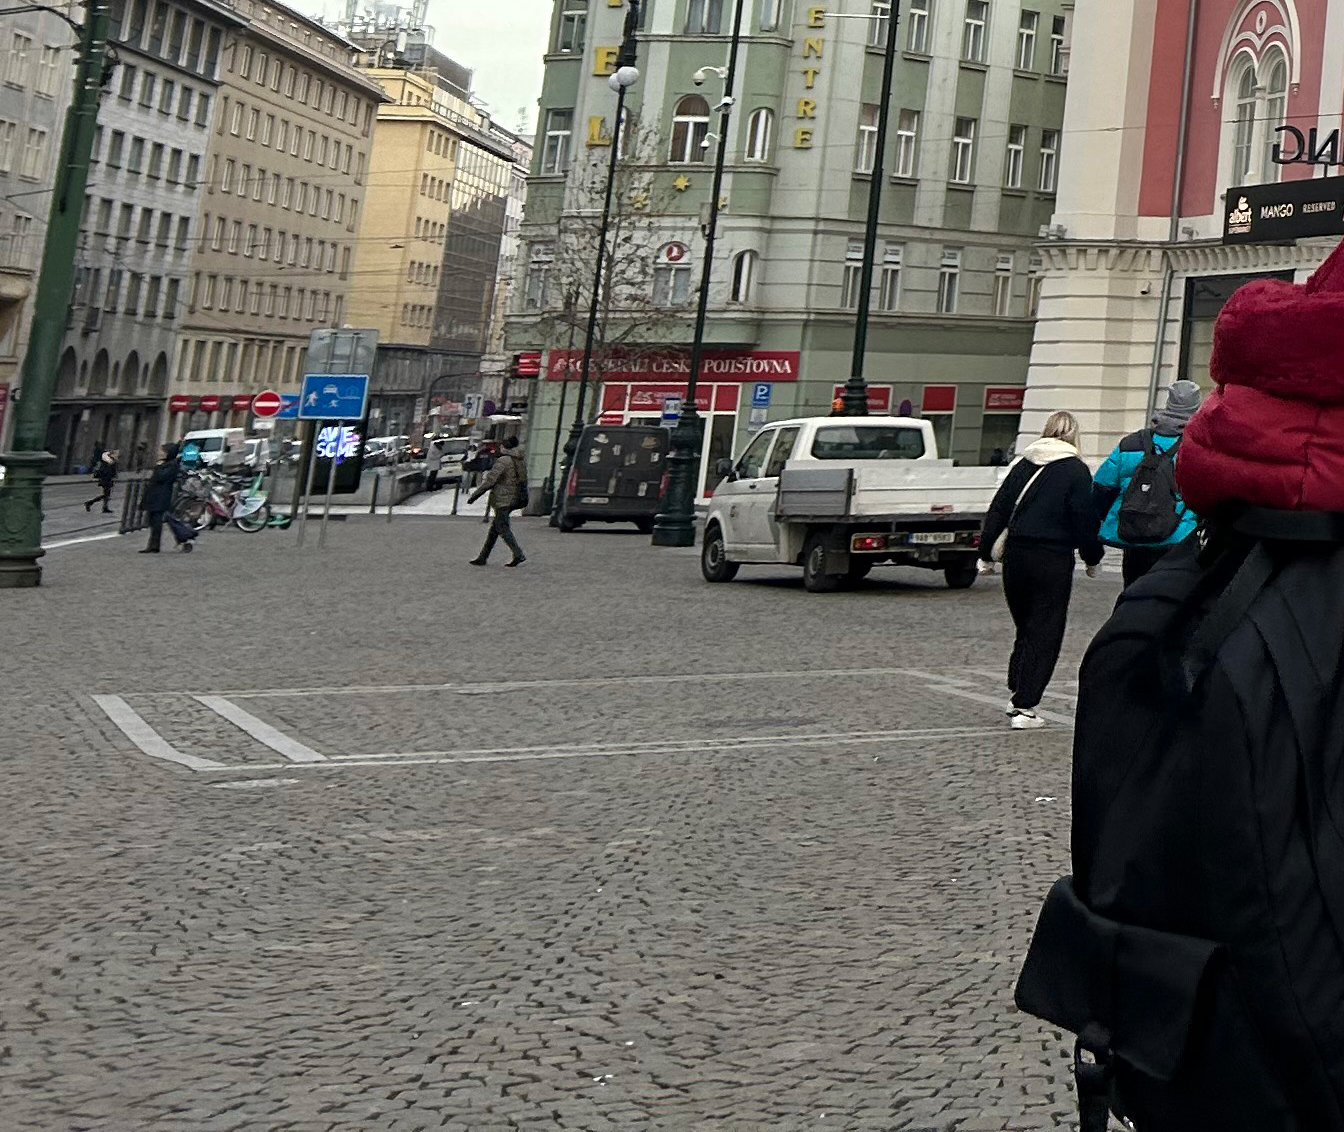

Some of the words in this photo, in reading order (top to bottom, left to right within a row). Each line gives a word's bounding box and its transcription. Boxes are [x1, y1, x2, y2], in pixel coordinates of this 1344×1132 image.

[1260, 203, 1294, 220] MANGO
[1302, 201, 1336, 213] RESERVED
[1229, 208, 1252, 224] albert
